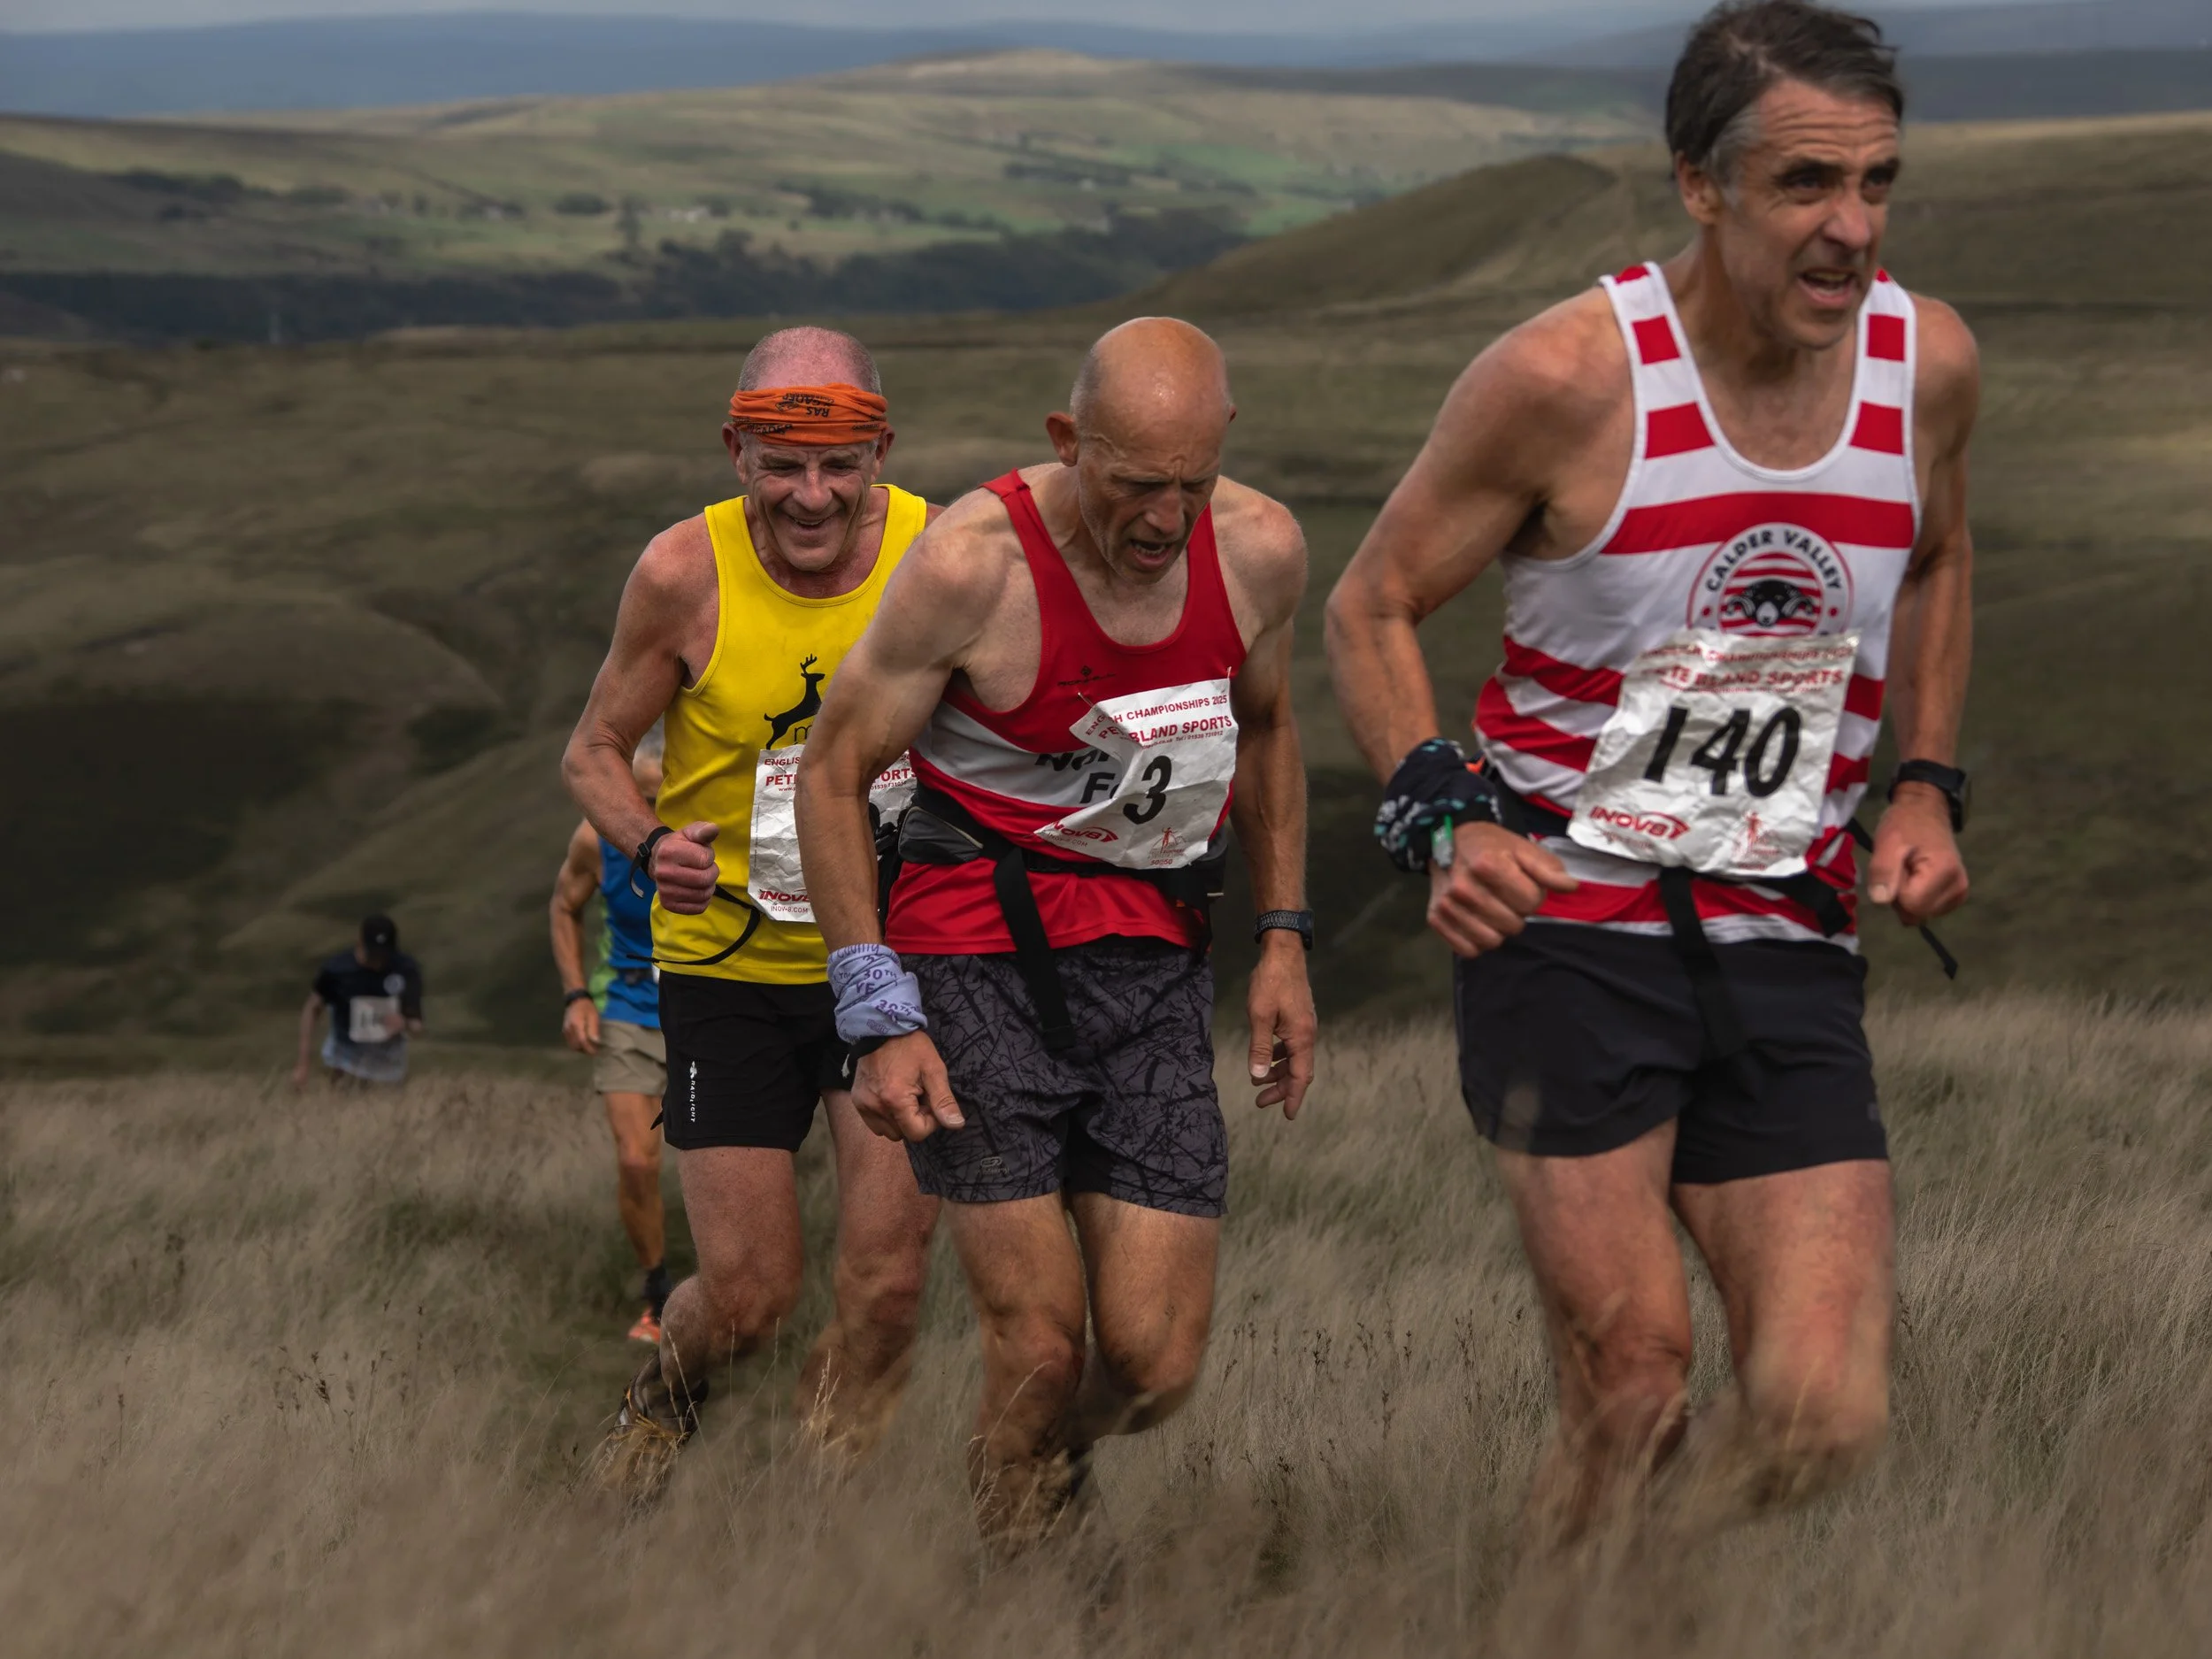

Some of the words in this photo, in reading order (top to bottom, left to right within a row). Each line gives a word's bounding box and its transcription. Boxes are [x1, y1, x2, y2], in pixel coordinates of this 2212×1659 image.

[806, 406, 830, 418] RAS
[1705, 530, 1773, 592] CALDER
[1784, 530, 1842, 590] VALLEY
[1767, 668, 1845, 686] SPORTS
[1085, 714, 1123, 736] ENGH
[1126, 697, 1210, 720] CHAMPIONSHIPS
[1211, 695, 1228, 705] 2025
[1129, 725, 1178, 743] BLAND
[1182, 715, 1233, 733] SPORTS
[764, 757, 801, 766] ENGLIS
[1642, 704, 1801, 798] 140
[1122, 755, 1172, 825] 3
[1053, 822, 1103, 841] NOV8
[1588, 805, 1670, 838] INOV8
